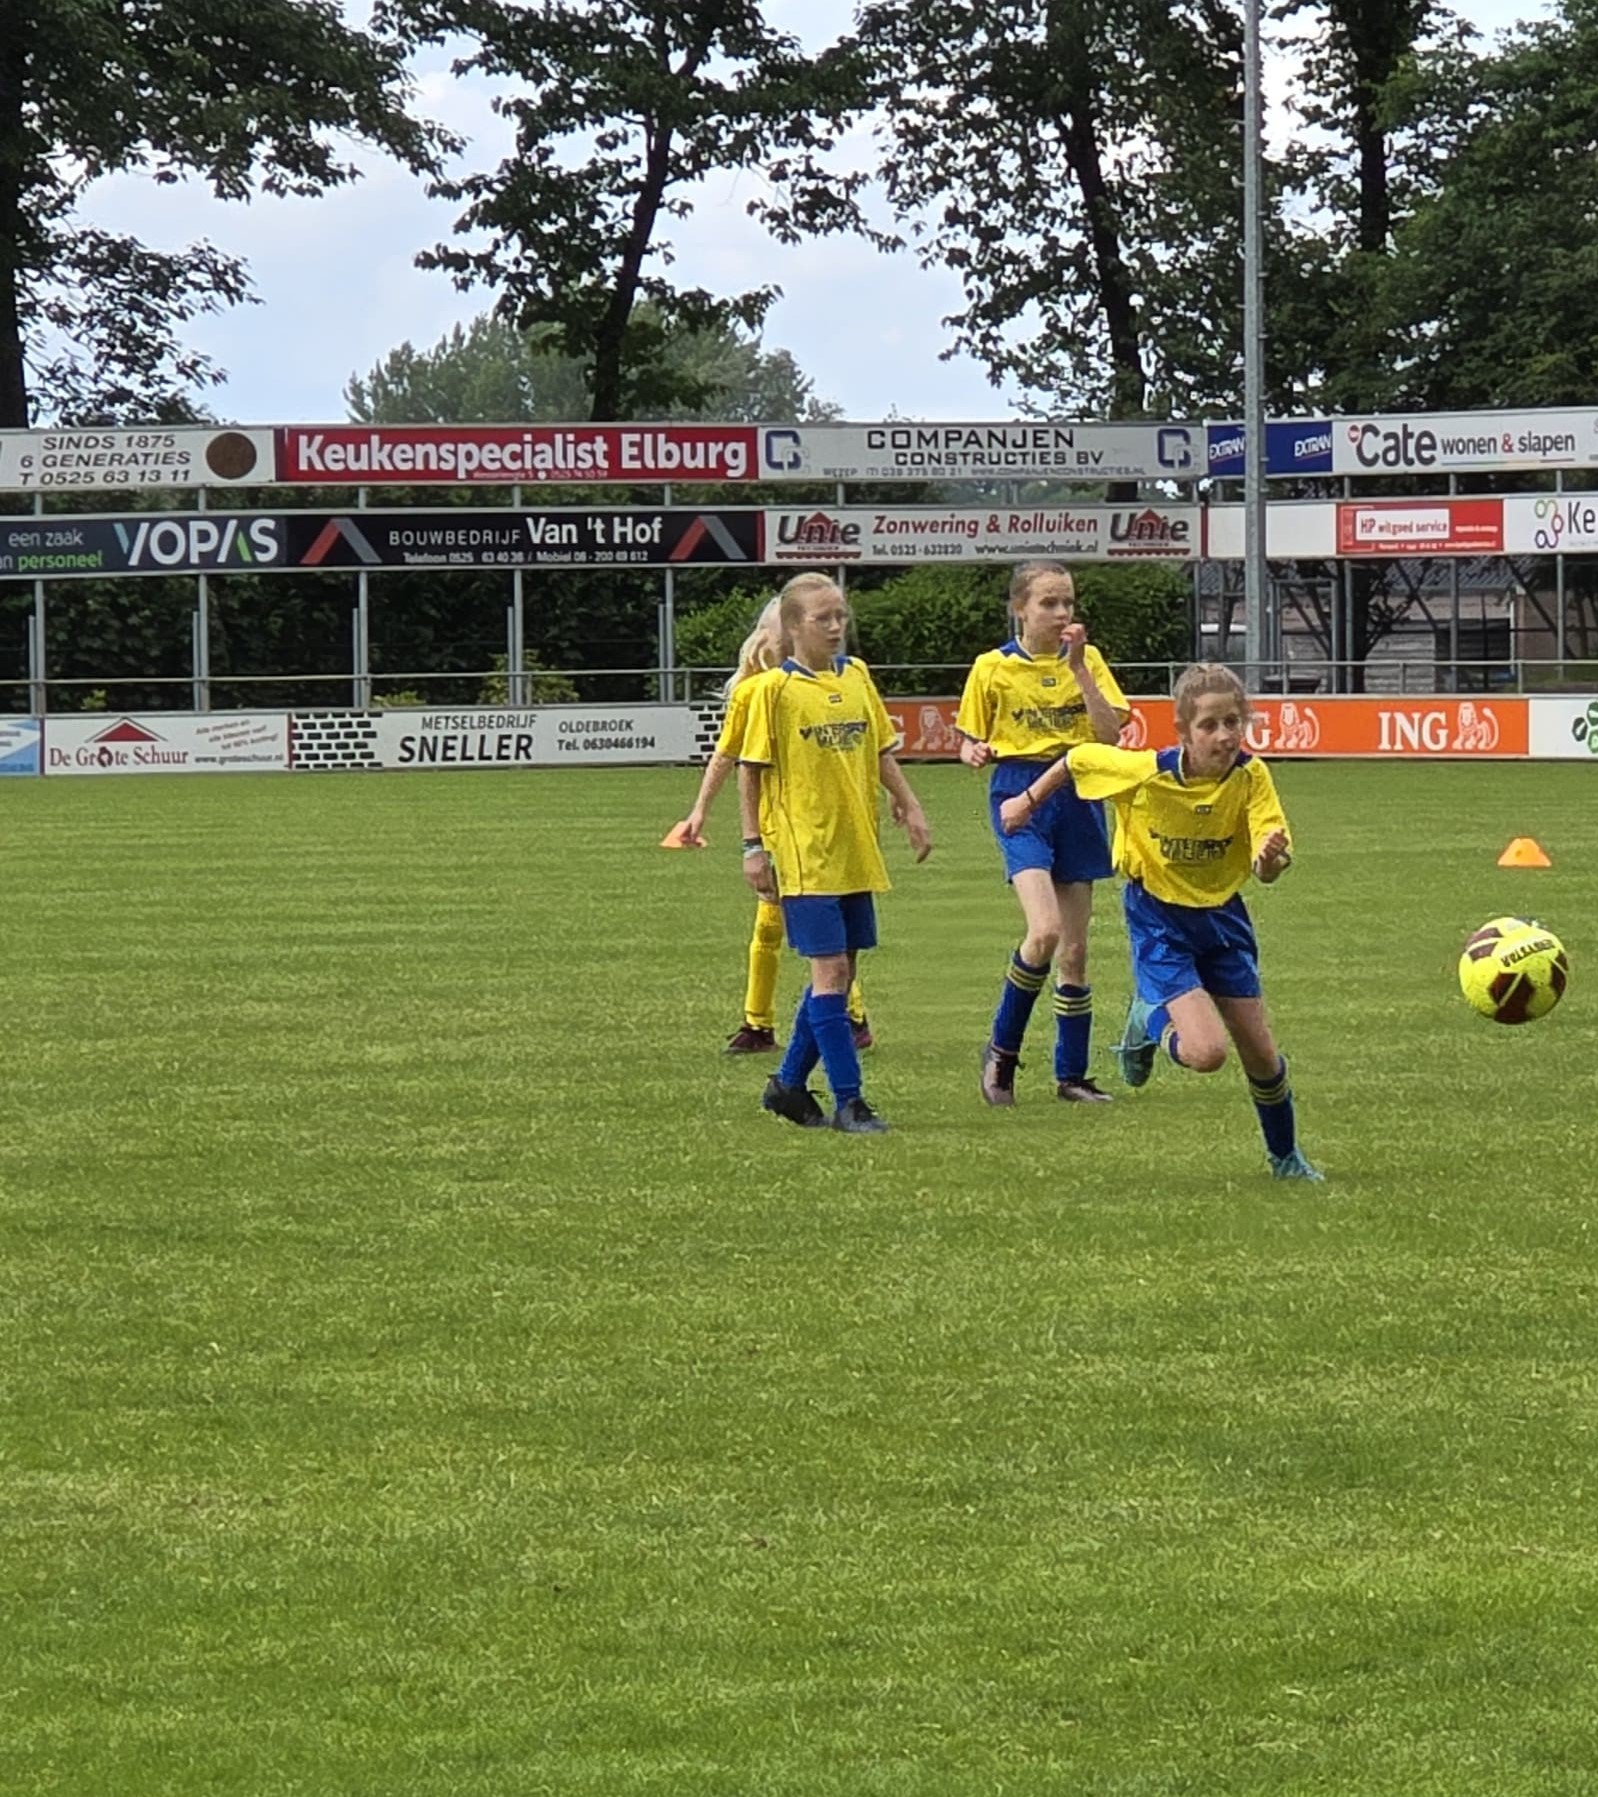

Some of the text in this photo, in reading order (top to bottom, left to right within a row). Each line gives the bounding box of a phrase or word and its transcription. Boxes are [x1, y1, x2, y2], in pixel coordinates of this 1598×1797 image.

[43, 434, 175, 450] SINDS 1875
[867, 429, 1074, 450] COMPANJEN
[1357, 423, 1437, 467] Cate
[1441, 437, 1496, 455] wonen
[1501, 433, 1515, 453] &
[1518, 431, 1576, 457] slapen
[20, 451, 191, 469] 6 GENERATIES
[298, 432, 747, 480] Keukenspecialist Elburg
[895, 450, 1104, 467] CONSTRUCTIES BV
[19, 469, 191, 486] T 0525 63 13 11
[388, 515, 663, 547] BOUWBEDRIJF Van 't Hof
[778, 513, 862, 545] Unie
[872, 511, 1098, 538] Zonwering & Rolluiken
[1109, 512, 1190, 542] Unie
[1360, 519, 1376, 534] HP
[1415, 518, 1448, 533] service
[8, 529, 84, 547] een zaak
[113, 518, 279, 566] VOPAS
[18, 549, 103, 571] personeel
[404, 551, 446, 563] Telefoon
[536, 549, 571, 562] Mobiel
[422, 714, 538, 731] METSELBEDRIJF
[559, 718, 635, 734] OLDEBROEK
[1378, 711, 1448, 752] ING
[398, 733, 533, 764] SNELLER
[557, 737, 580, 753] Tel.
[50, 748, 71, 768] De
[133, 745, 189, 766] Schuur
